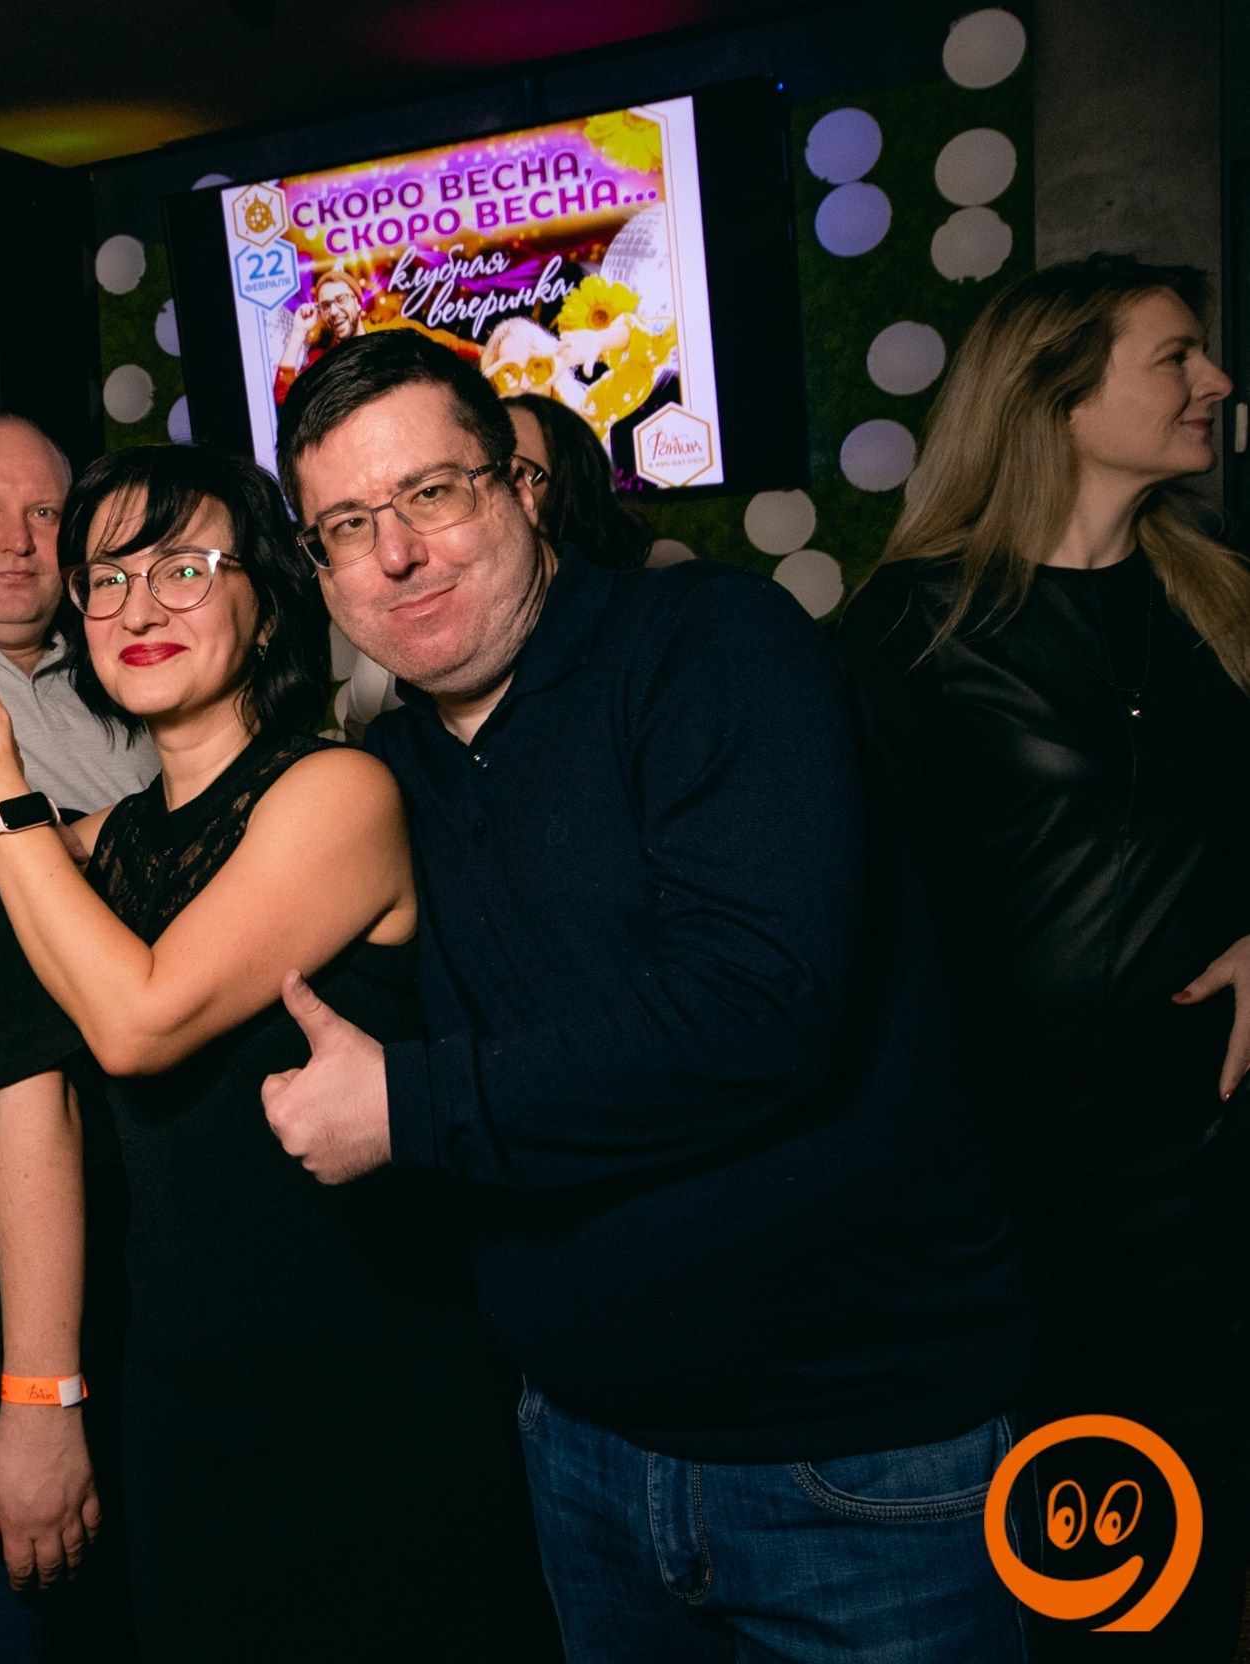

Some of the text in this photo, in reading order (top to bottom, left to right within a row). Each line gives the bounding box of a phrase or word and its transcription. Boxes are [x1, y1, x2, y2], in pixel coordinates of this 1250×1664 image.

[292, 152, 593, 229] СКОРО ВЕСНА,
[326, 180, 658, 255] СКОРО ВЕСНА...
[245, 277, 291, 292] ФЕВРАЛЯ
[246, 250, 285, 280] 22
[387, 244, 511, 317] клубная
[427, 255, 575, 339] вечеринка
